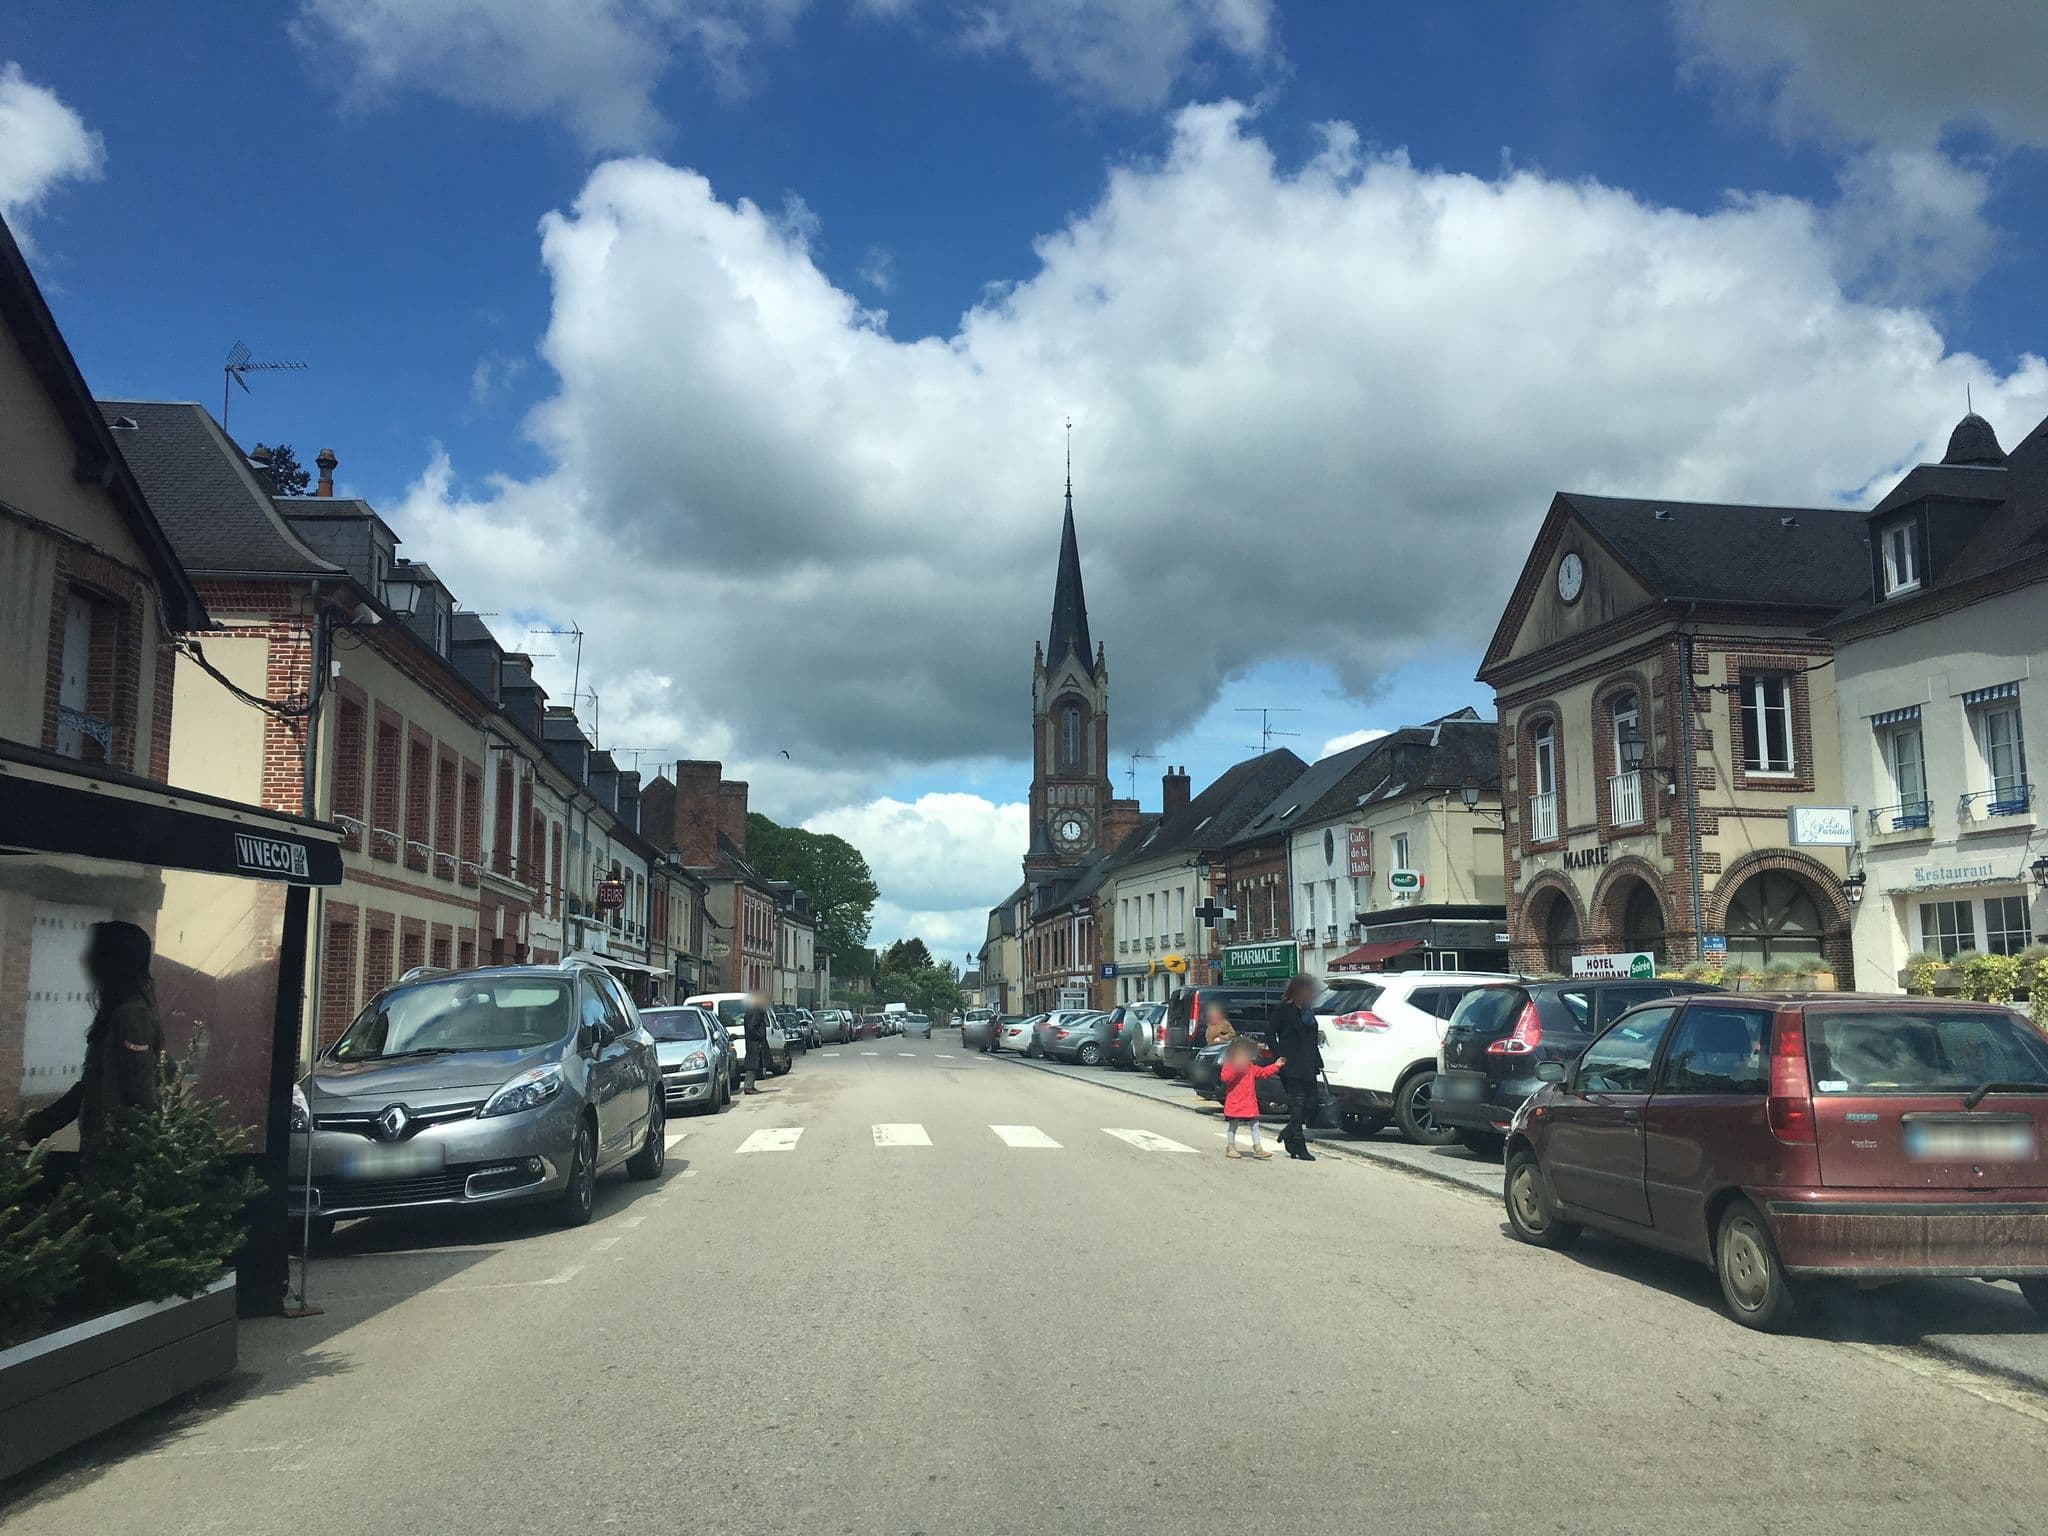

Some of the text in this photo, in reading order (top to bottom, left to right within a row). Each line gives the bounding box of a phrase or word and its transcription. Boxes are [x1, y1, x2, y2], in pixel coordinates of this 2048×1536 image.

[1813, 823, 1850, 835] Paradis
[1822, 816, 1840, 829] Le
[1349, 831, 1366, 843] Café
[238, 838, 290, 869] VIVECO
[1350, 846, 1368, 858] de la
[1563, 846, 1609, 869] MAIRIE
[1351, 861, 1370, 873] Halle
[1914, 862, 1994, 882] Restaurant
[600, 888, 624, 903] FLEURS
[1231, 947, 1281, 966] PHARMACIE
[1586, 956, 1614, 970] HÔTEL
